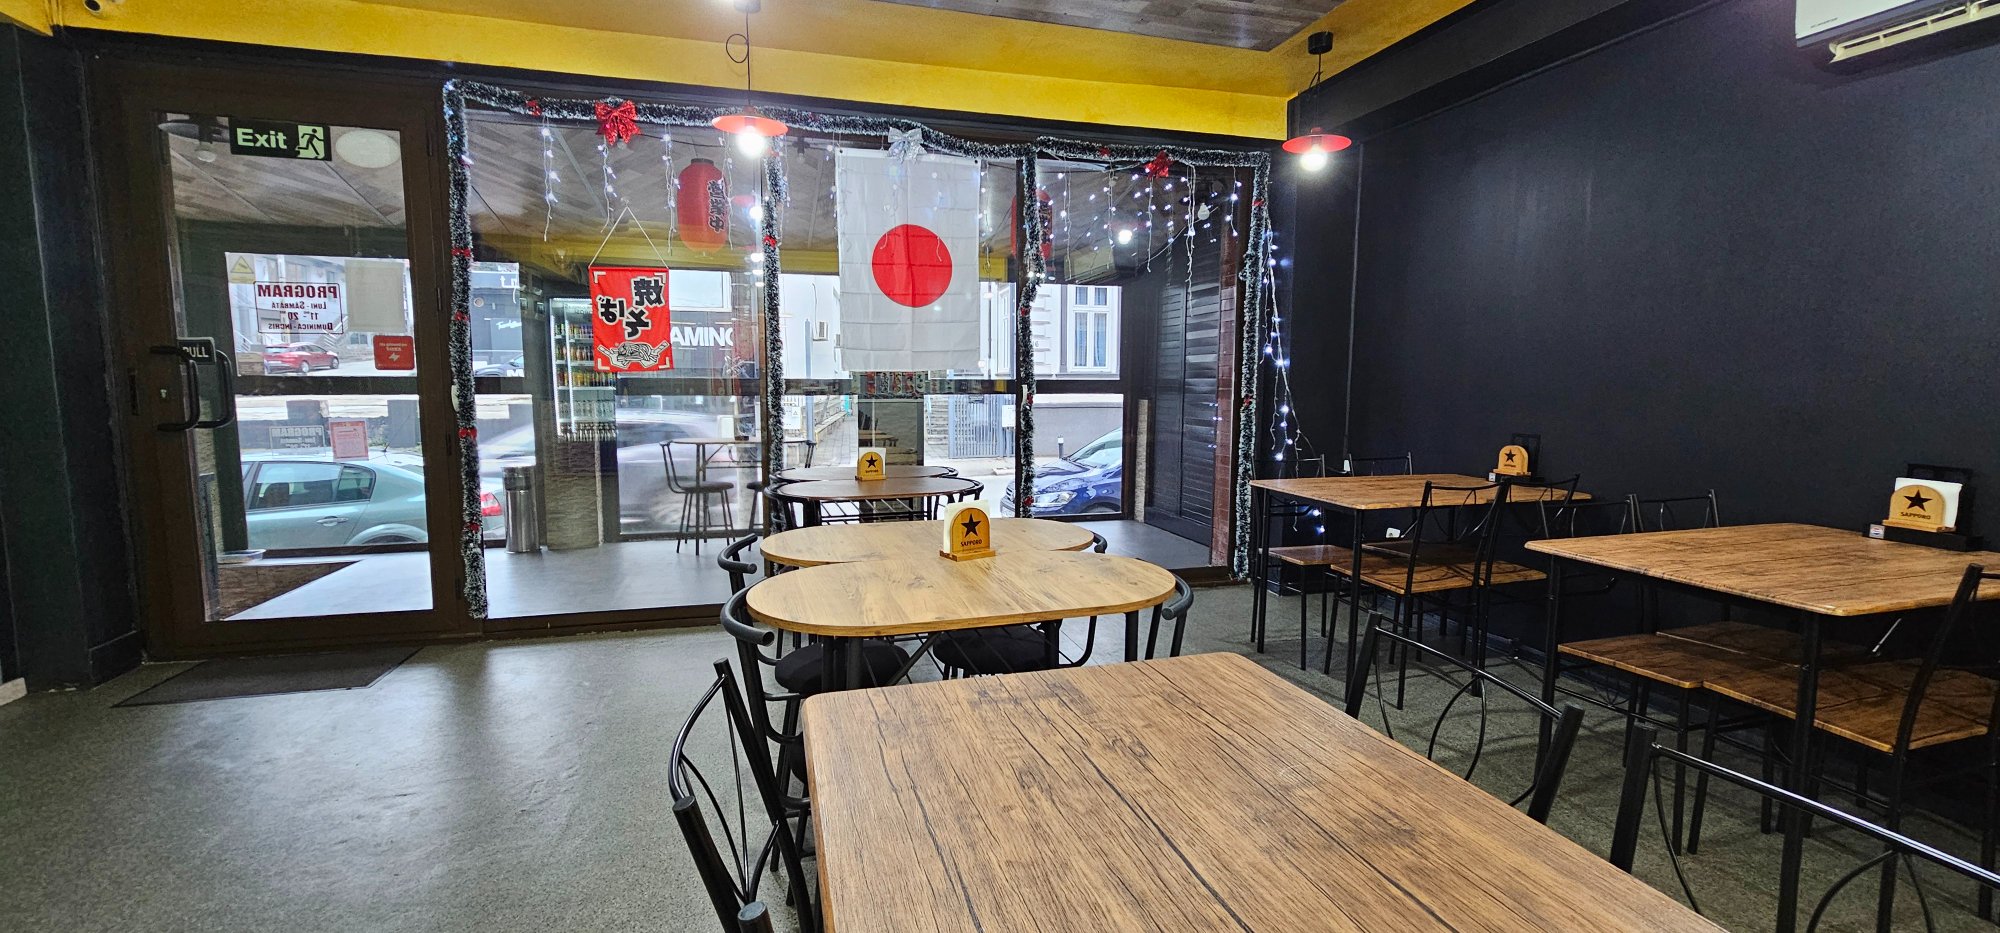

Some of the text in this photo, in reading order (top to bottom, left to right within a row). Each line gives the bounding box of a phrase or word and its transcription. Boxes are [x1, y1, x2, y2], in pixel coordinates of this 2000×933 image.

[236, 127, 287, 149] Exit
[1900, 511, 1931, 520] SAPPORO
[960, 539, 983, 547] SAPPORO
